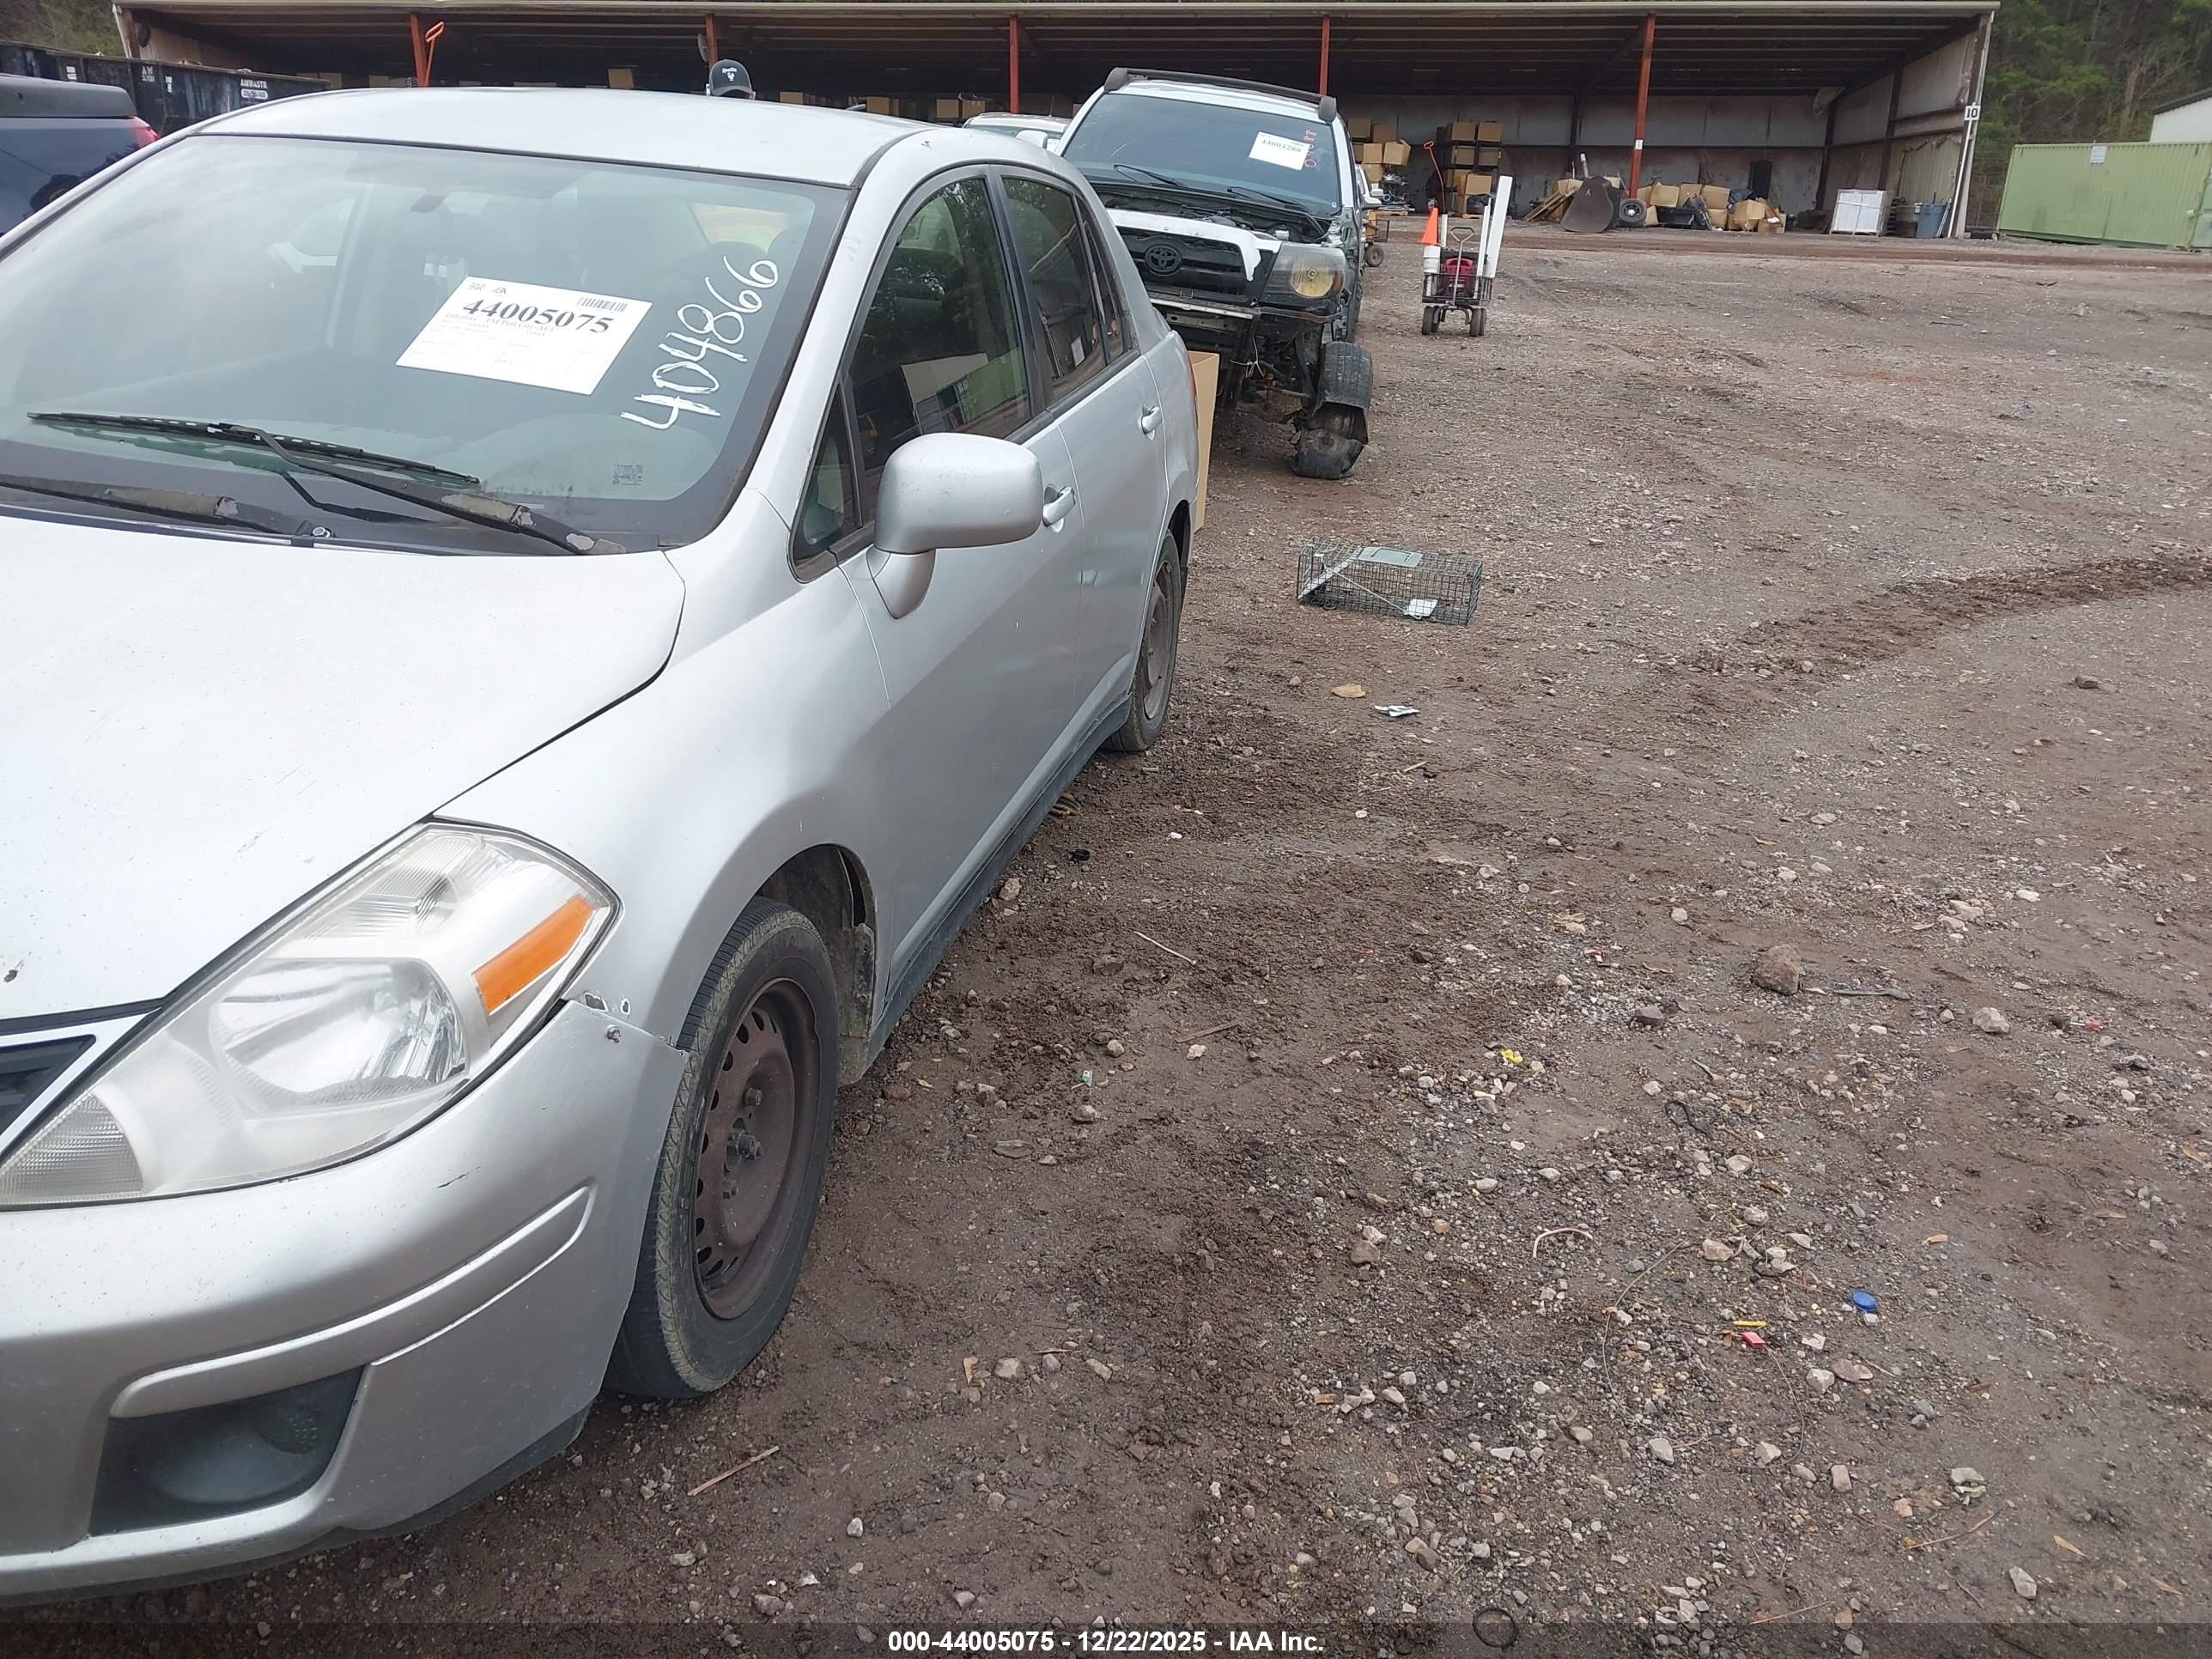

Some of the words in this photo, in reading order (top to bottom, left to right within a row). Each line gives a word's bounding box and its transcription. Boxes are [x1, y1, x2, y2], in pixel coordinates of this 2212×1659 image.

[1966, 108, 1978, 118] 10
[463, 299, 614, 333] 44005075
[620, 255, 779, 429] 404866
